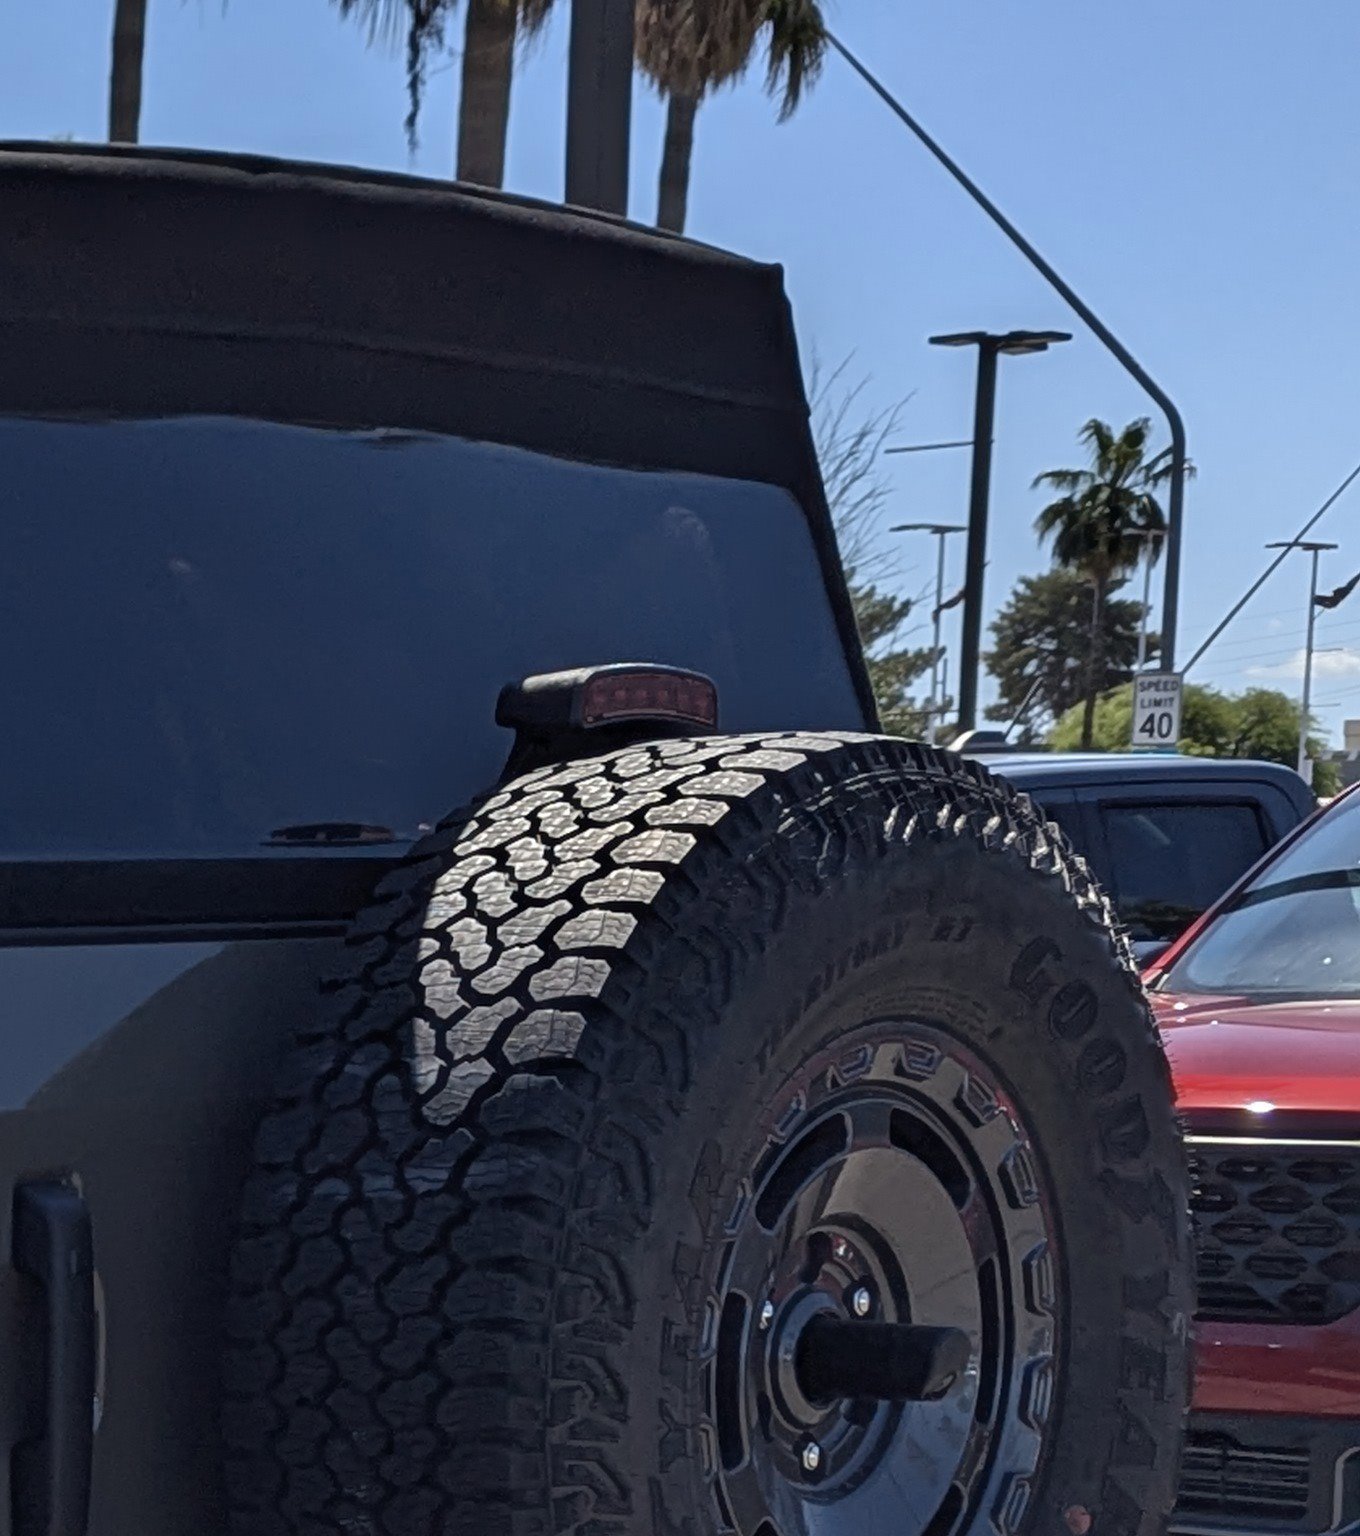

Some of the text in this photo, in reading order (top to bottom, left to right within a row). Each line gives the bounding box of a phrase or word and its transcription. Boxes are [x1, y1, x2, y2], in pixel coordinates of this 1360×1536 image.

[1138, 680, 1179, 692] SPEED
[1140, 698, 1175, 709] LIMIT
[1139, 712, 1173, 739] 40
